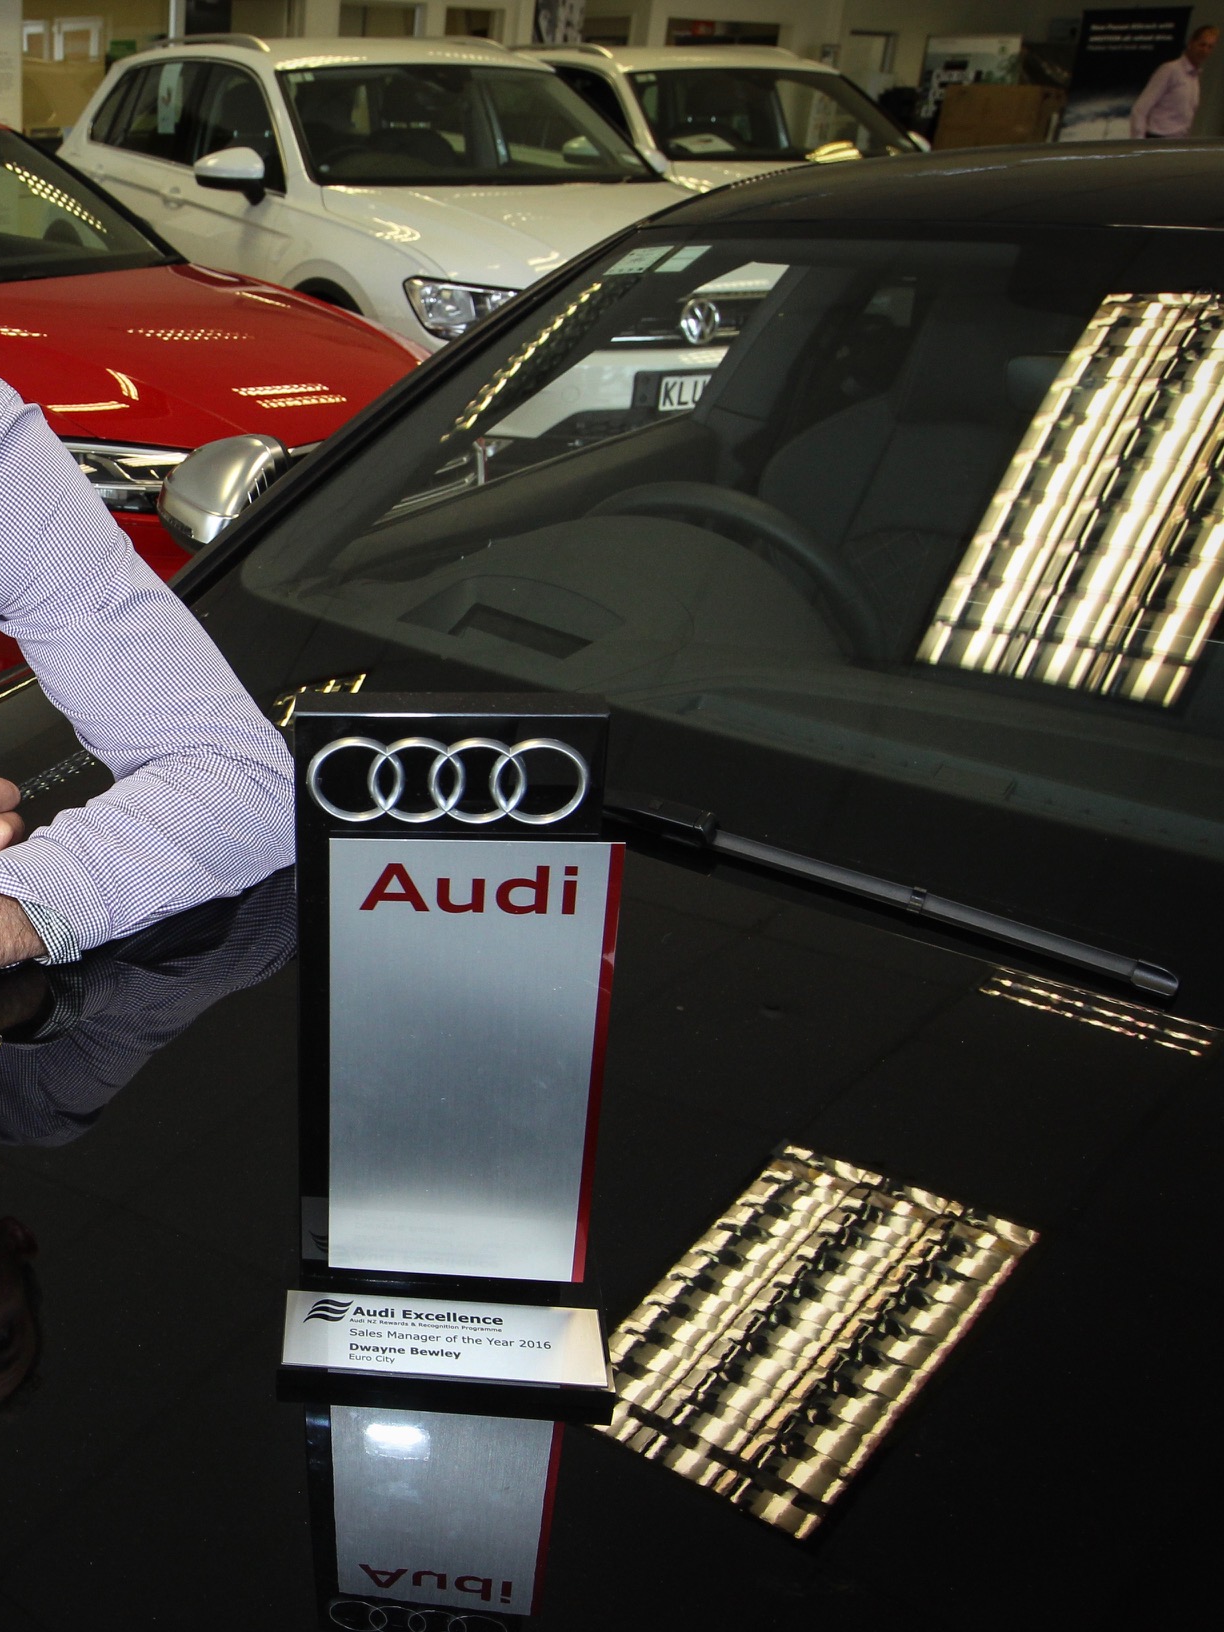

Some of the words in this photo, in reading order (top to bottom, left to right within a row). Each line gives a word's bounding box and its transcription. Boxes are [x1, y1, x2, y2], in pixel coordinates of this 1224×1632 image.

[359, 863, 578, 915] Audi
[353, 1306, 395, 1318] Audi
[402, 1309, 504, 1326] Excellence
[461, 1325, 503, 1333] Programme
[349, 1328, 383, 1338] Sales
[387, 1330, 441, 1343] Manager
[445, 1334, 459, 1343] of
[461, 1335, 483, 1345] the
[486, 1337, 514, 1347] Year
[519, 1339, 552, 1350] 2016
[349, 1342, 406, 1355] Dwayne
[410, 1347, 462, 1360] Bewley
[349, 1353, 372, 1362] Euro
[375, 1354, 396, 1364] City
